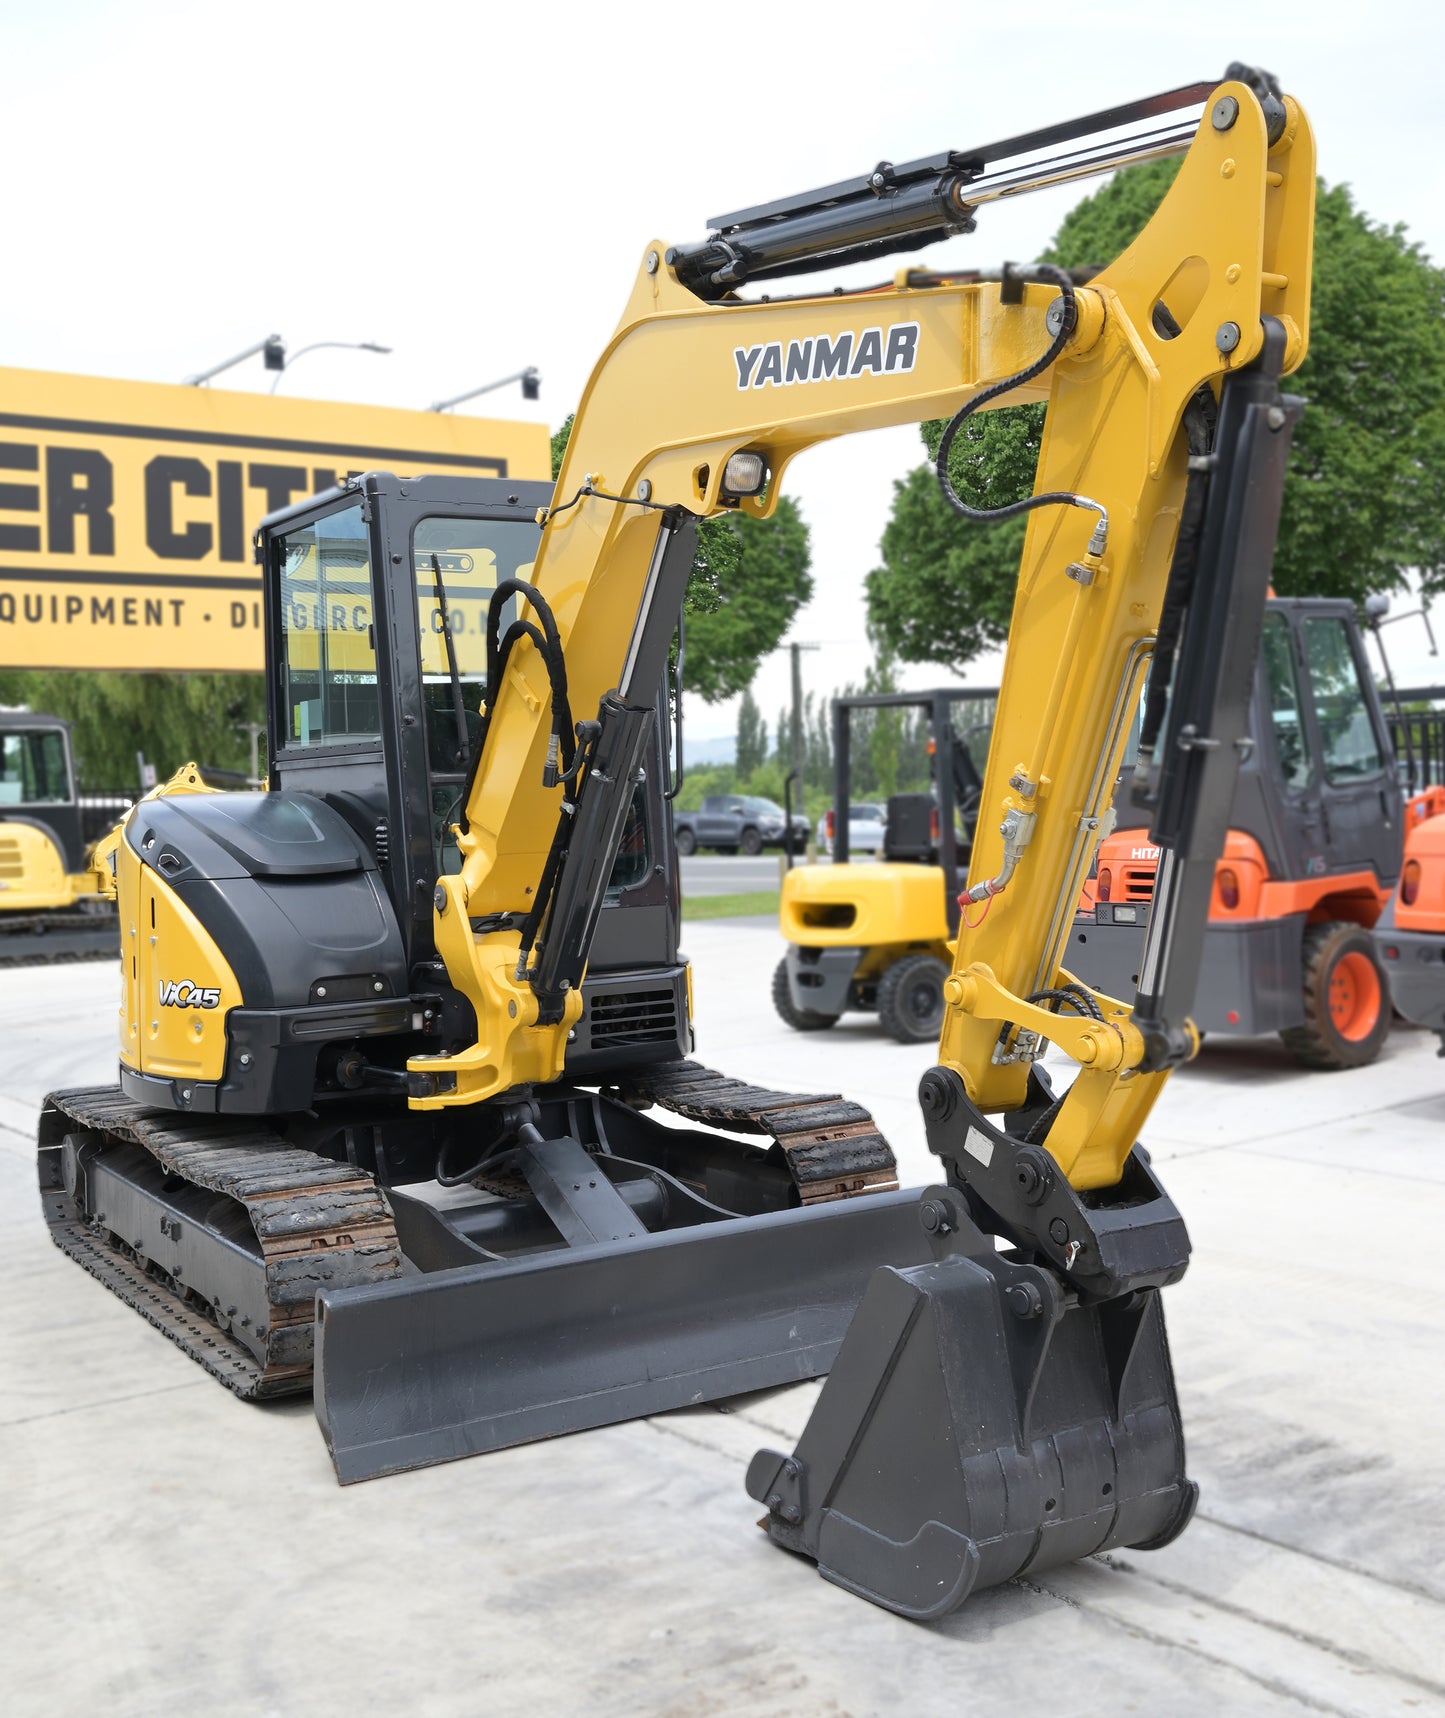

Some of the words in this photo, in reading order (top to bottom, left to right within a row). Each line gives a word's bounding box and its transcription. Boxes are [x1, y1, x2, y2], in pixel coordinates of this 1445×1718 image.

[733, 321, 920, 390] YANMAR
[0, 441, 115, 557] ER
[144, 454, 365, 563] CIT
[0, 592, 184, 627] QUIPMENT
[1131, 847, 1160, 860] HITA
